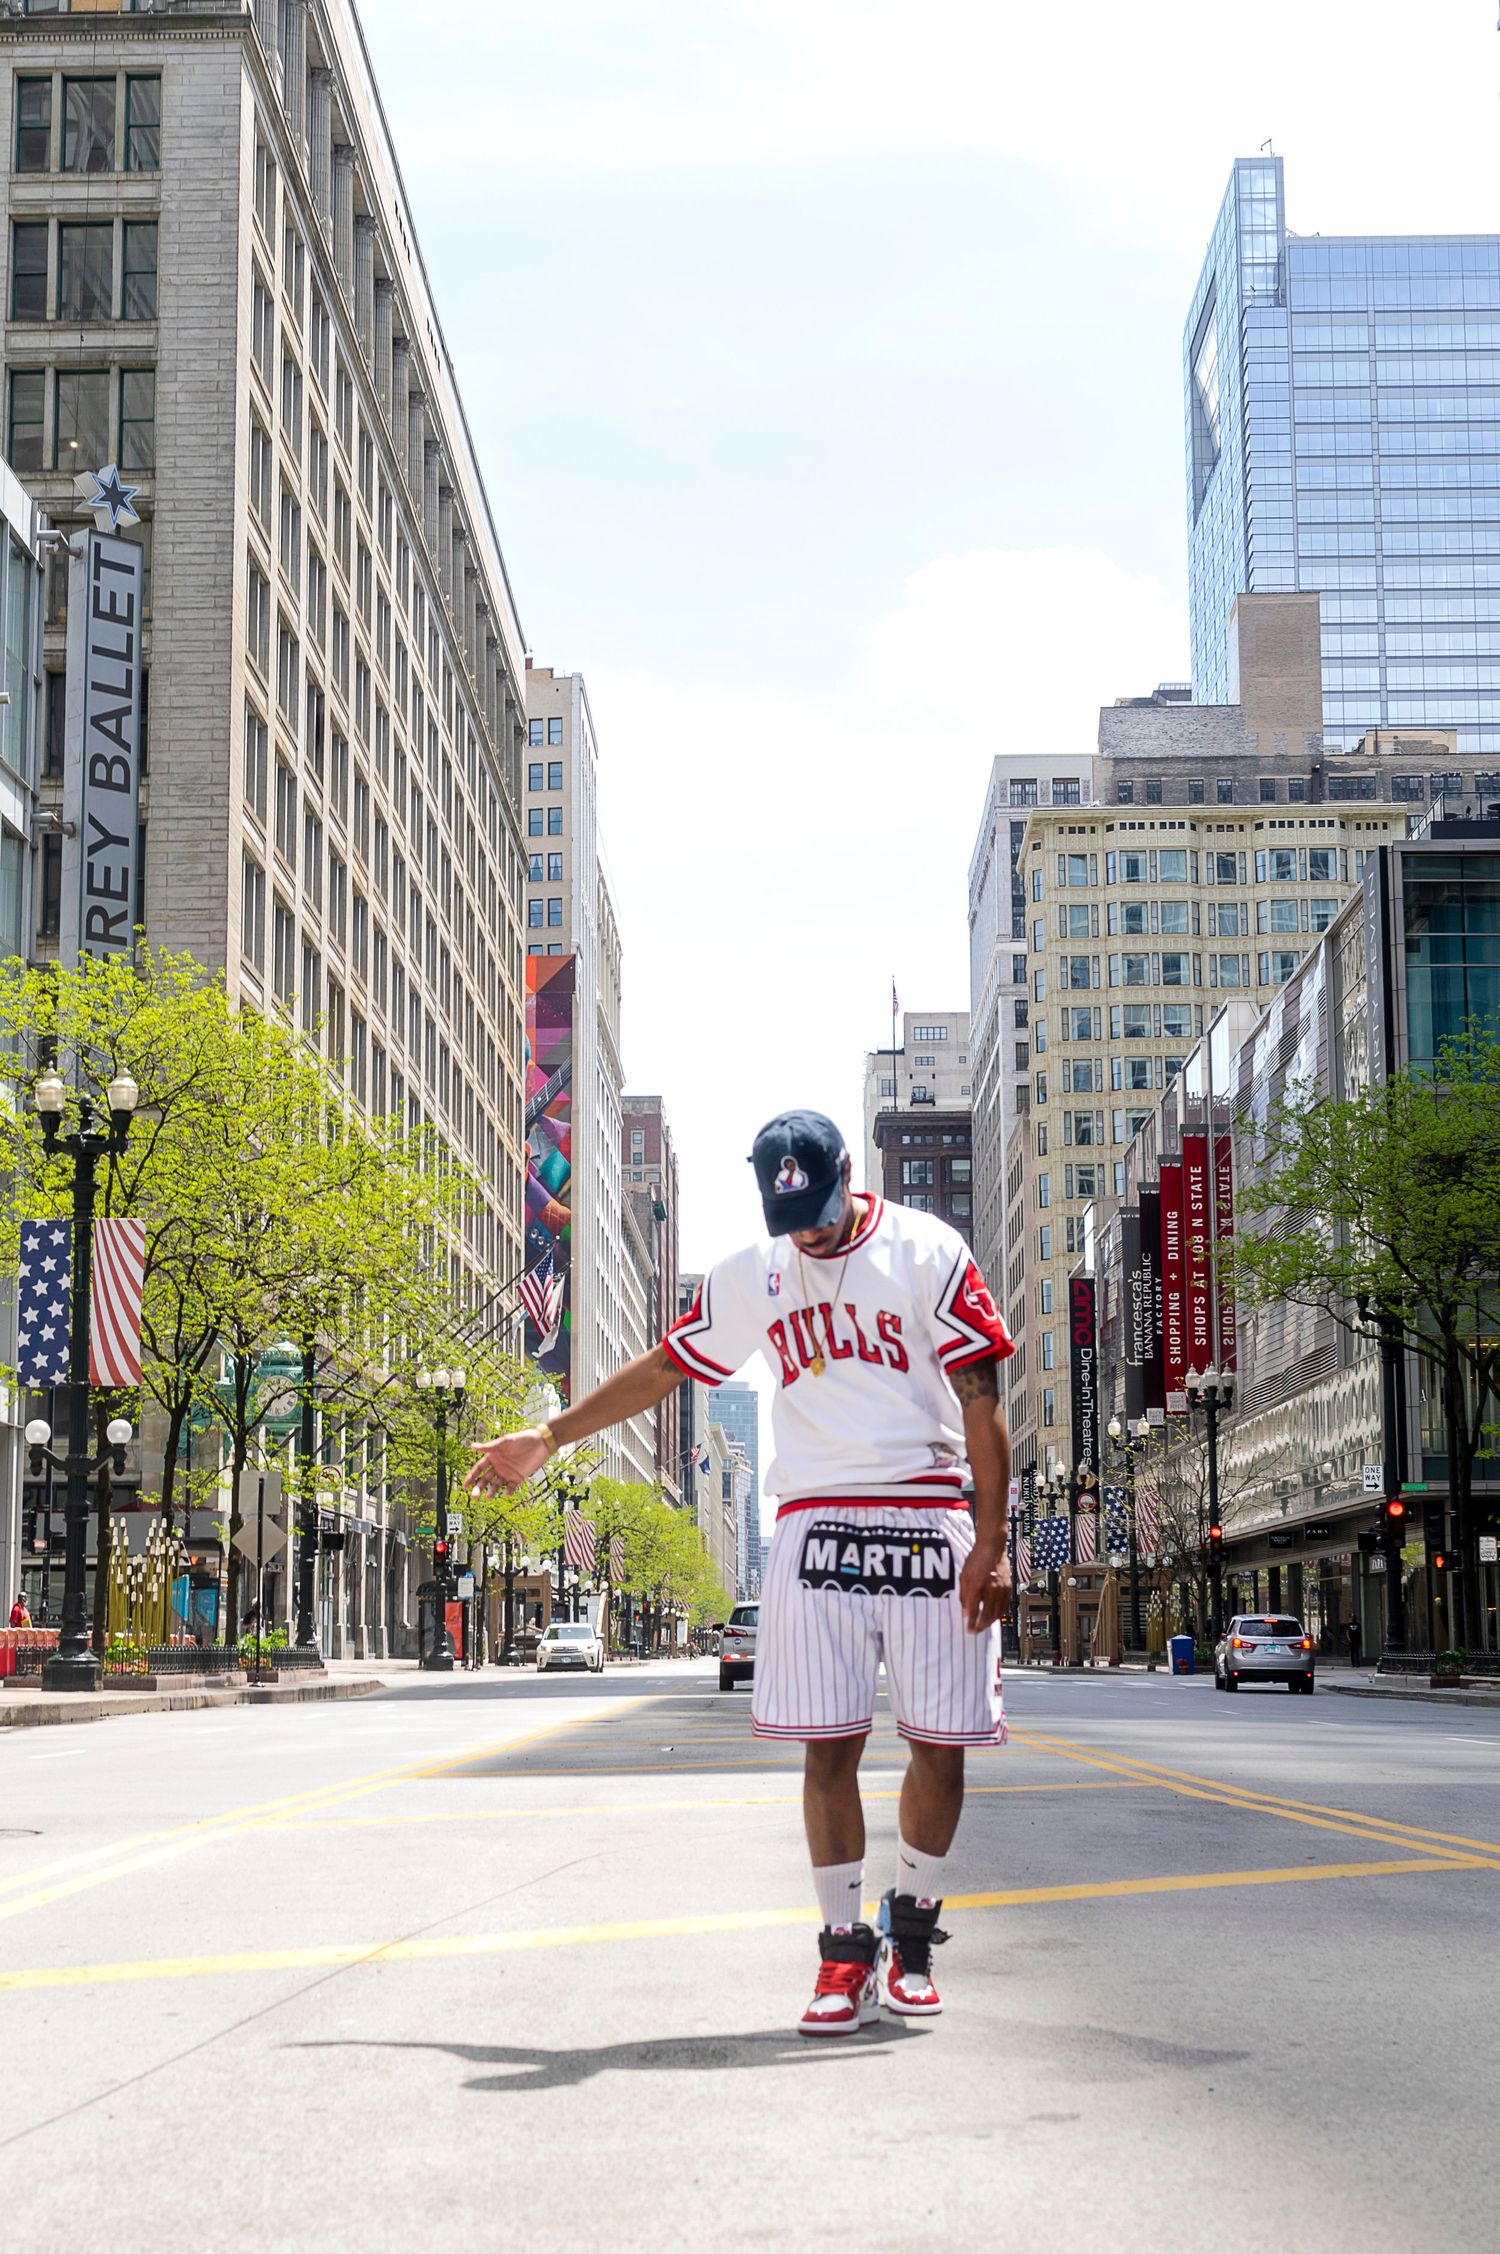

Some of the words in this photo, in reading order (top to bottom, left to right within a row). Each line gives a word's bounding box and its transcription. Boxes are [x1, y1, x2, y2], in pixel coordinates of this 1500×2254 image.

[89, 541, 135, 794] BALLET
[1368, 871, 1378, 985] SEVEN
[1189, 1165, 1203, 1210] STATE
[1166, 1211, 1179, 1260] DINING
[1191, 1218, 1204, 1227] N
[1142, 1252, 1153, 1308] REPUBLIC
[1154, 1277, 1164, 1335] FACTORY
[1192, 1271, 1205, 1288] AT
[767, 1302, 910, 1389] BULLS
[1126, 1270, 1144, 1367] francesca's
[1144, 1311, 1154, 1359] BANANA
[1168, 1292, 1182, 1365] SHOPPING
[1193, 1296, 1207, 1346] SHOPS
[1082, 1398, 1094, 1467] Theatres
[1364, 1466, 1381, 1474] ONE
